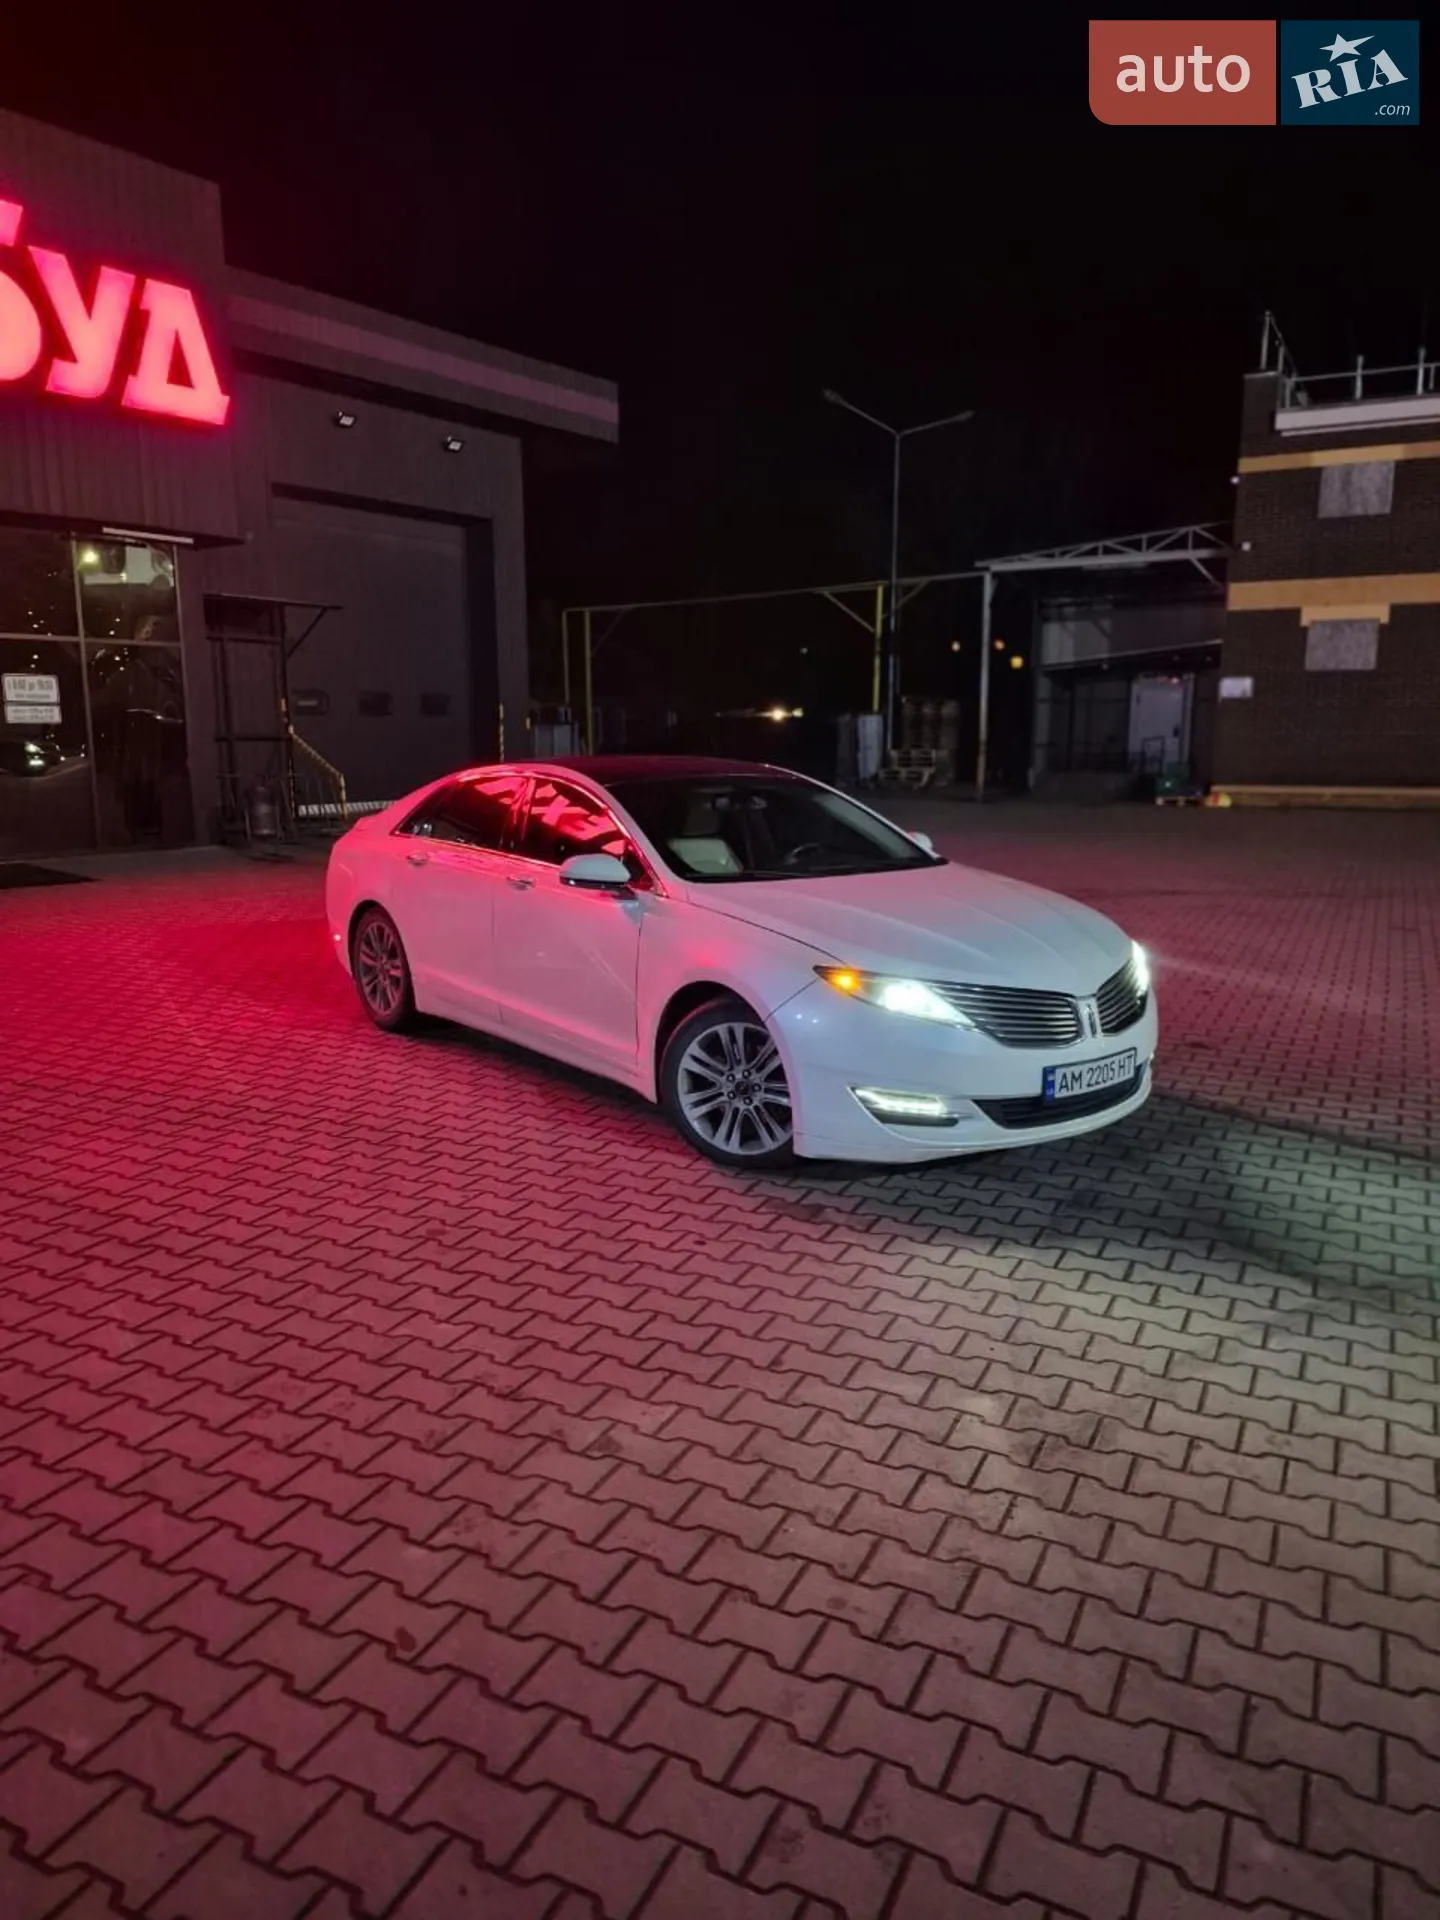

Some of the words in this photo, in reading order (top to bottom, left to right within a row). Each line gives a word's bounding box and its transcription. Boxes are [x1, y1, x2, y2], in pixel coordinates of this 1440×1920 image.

[1059, 1071, 1083, 1092] AM
[1086, 1061, 1116, 1088] 2205
[1118, 1053, 1134, 1078] HT
